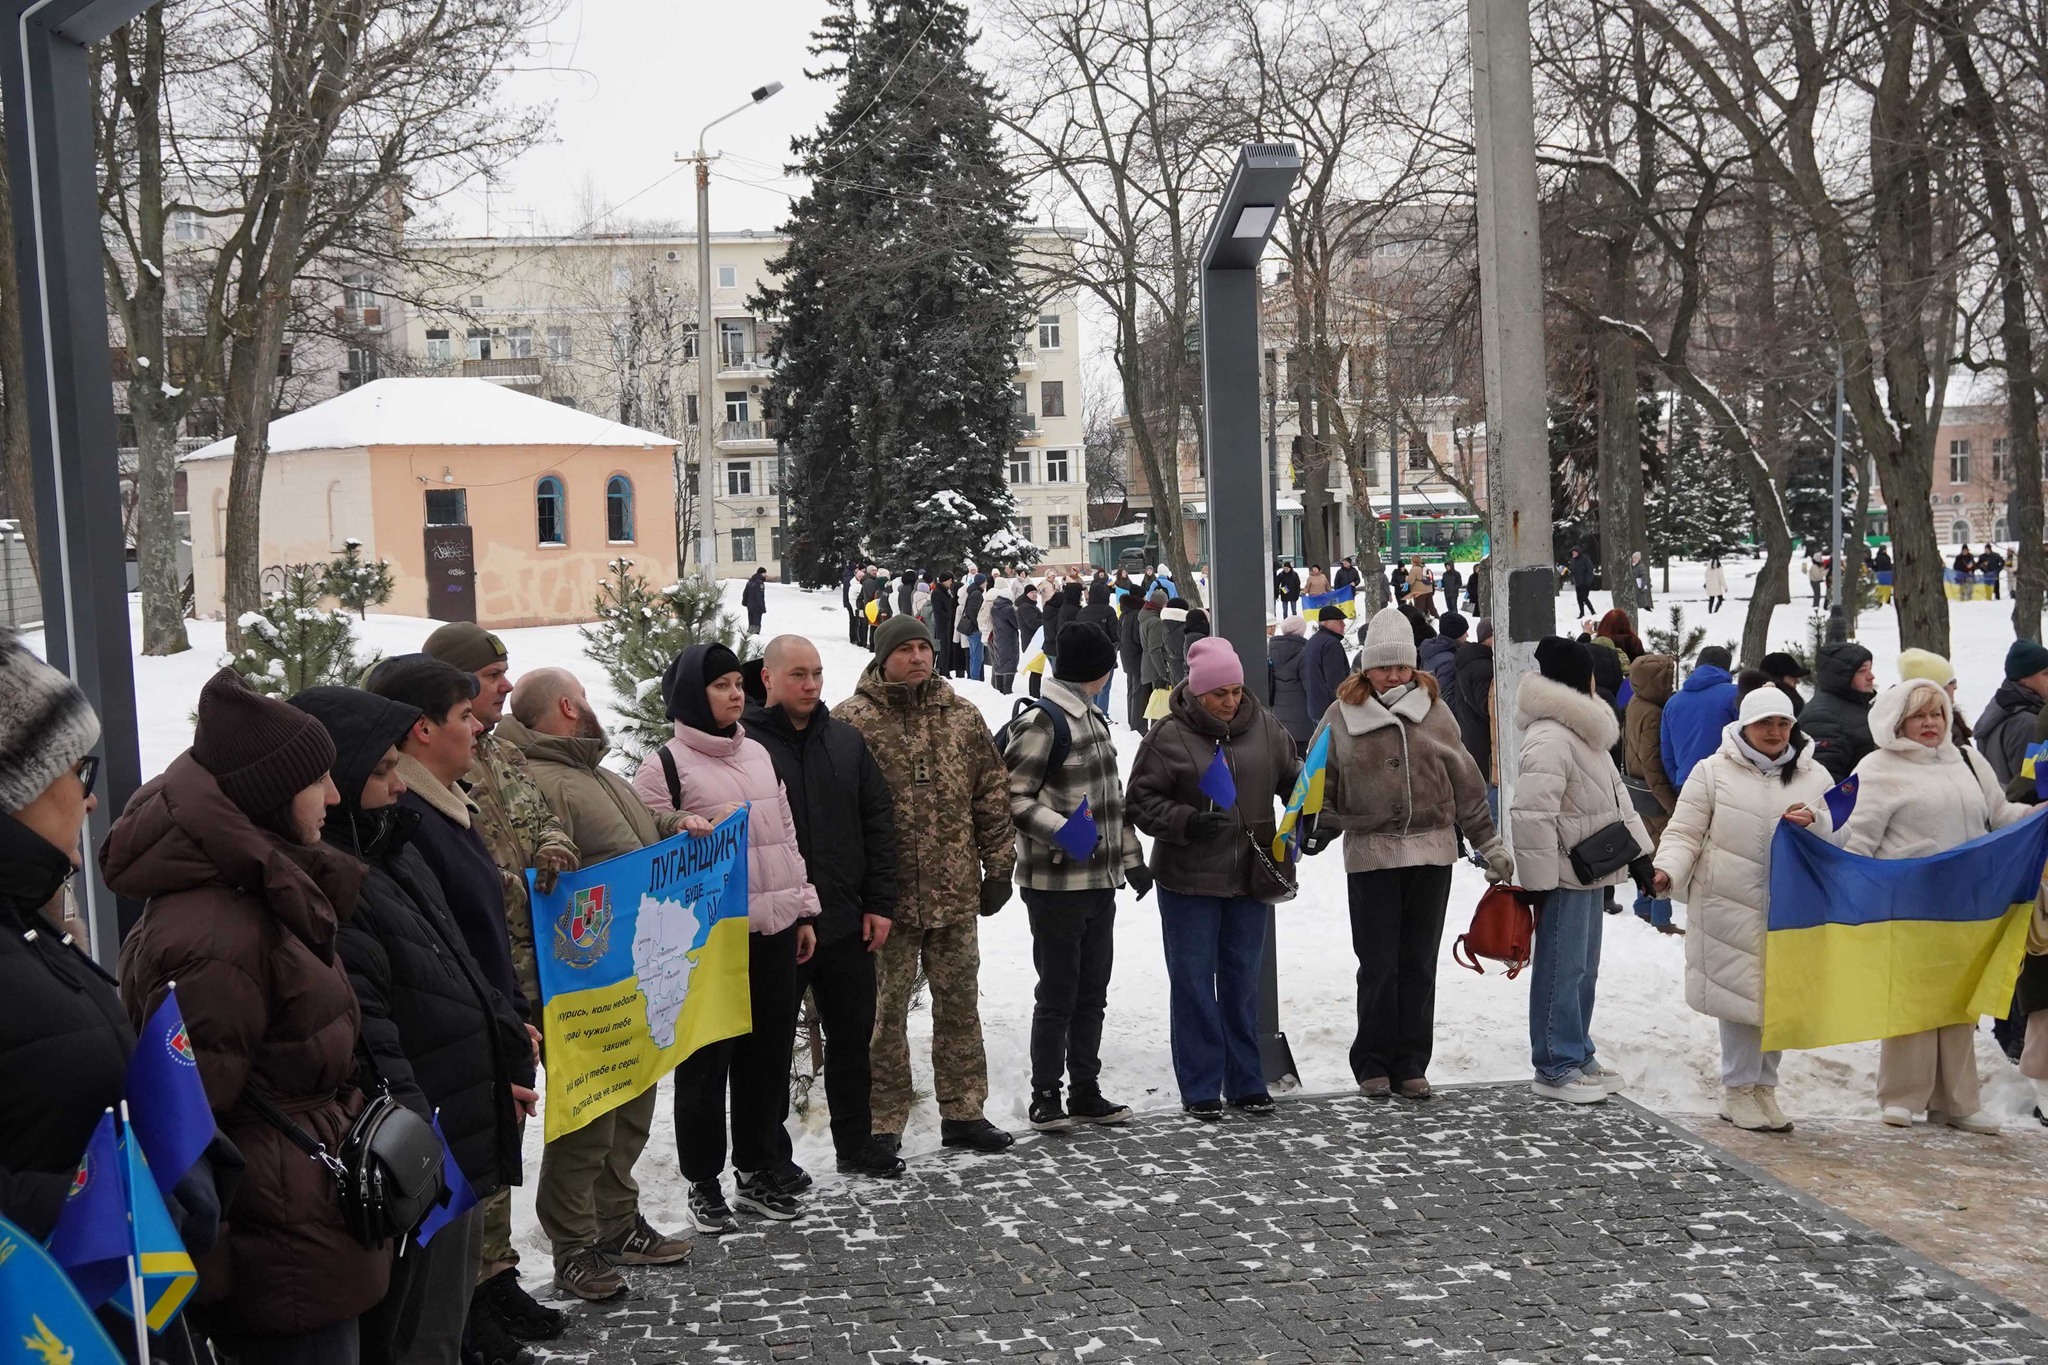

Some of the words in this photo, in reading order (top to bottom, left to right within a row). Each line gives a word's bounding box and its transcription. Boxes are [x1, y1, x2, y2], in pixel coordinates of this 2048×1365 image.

[685, 882, 704, 904] БУДЕ
[591, 1003, 612, 1015] коли
[583, 1023, 611, 1039] чужий
[612, 1016, 632, 1031] тебе
[589, 1064, 610, 1079] тебе
